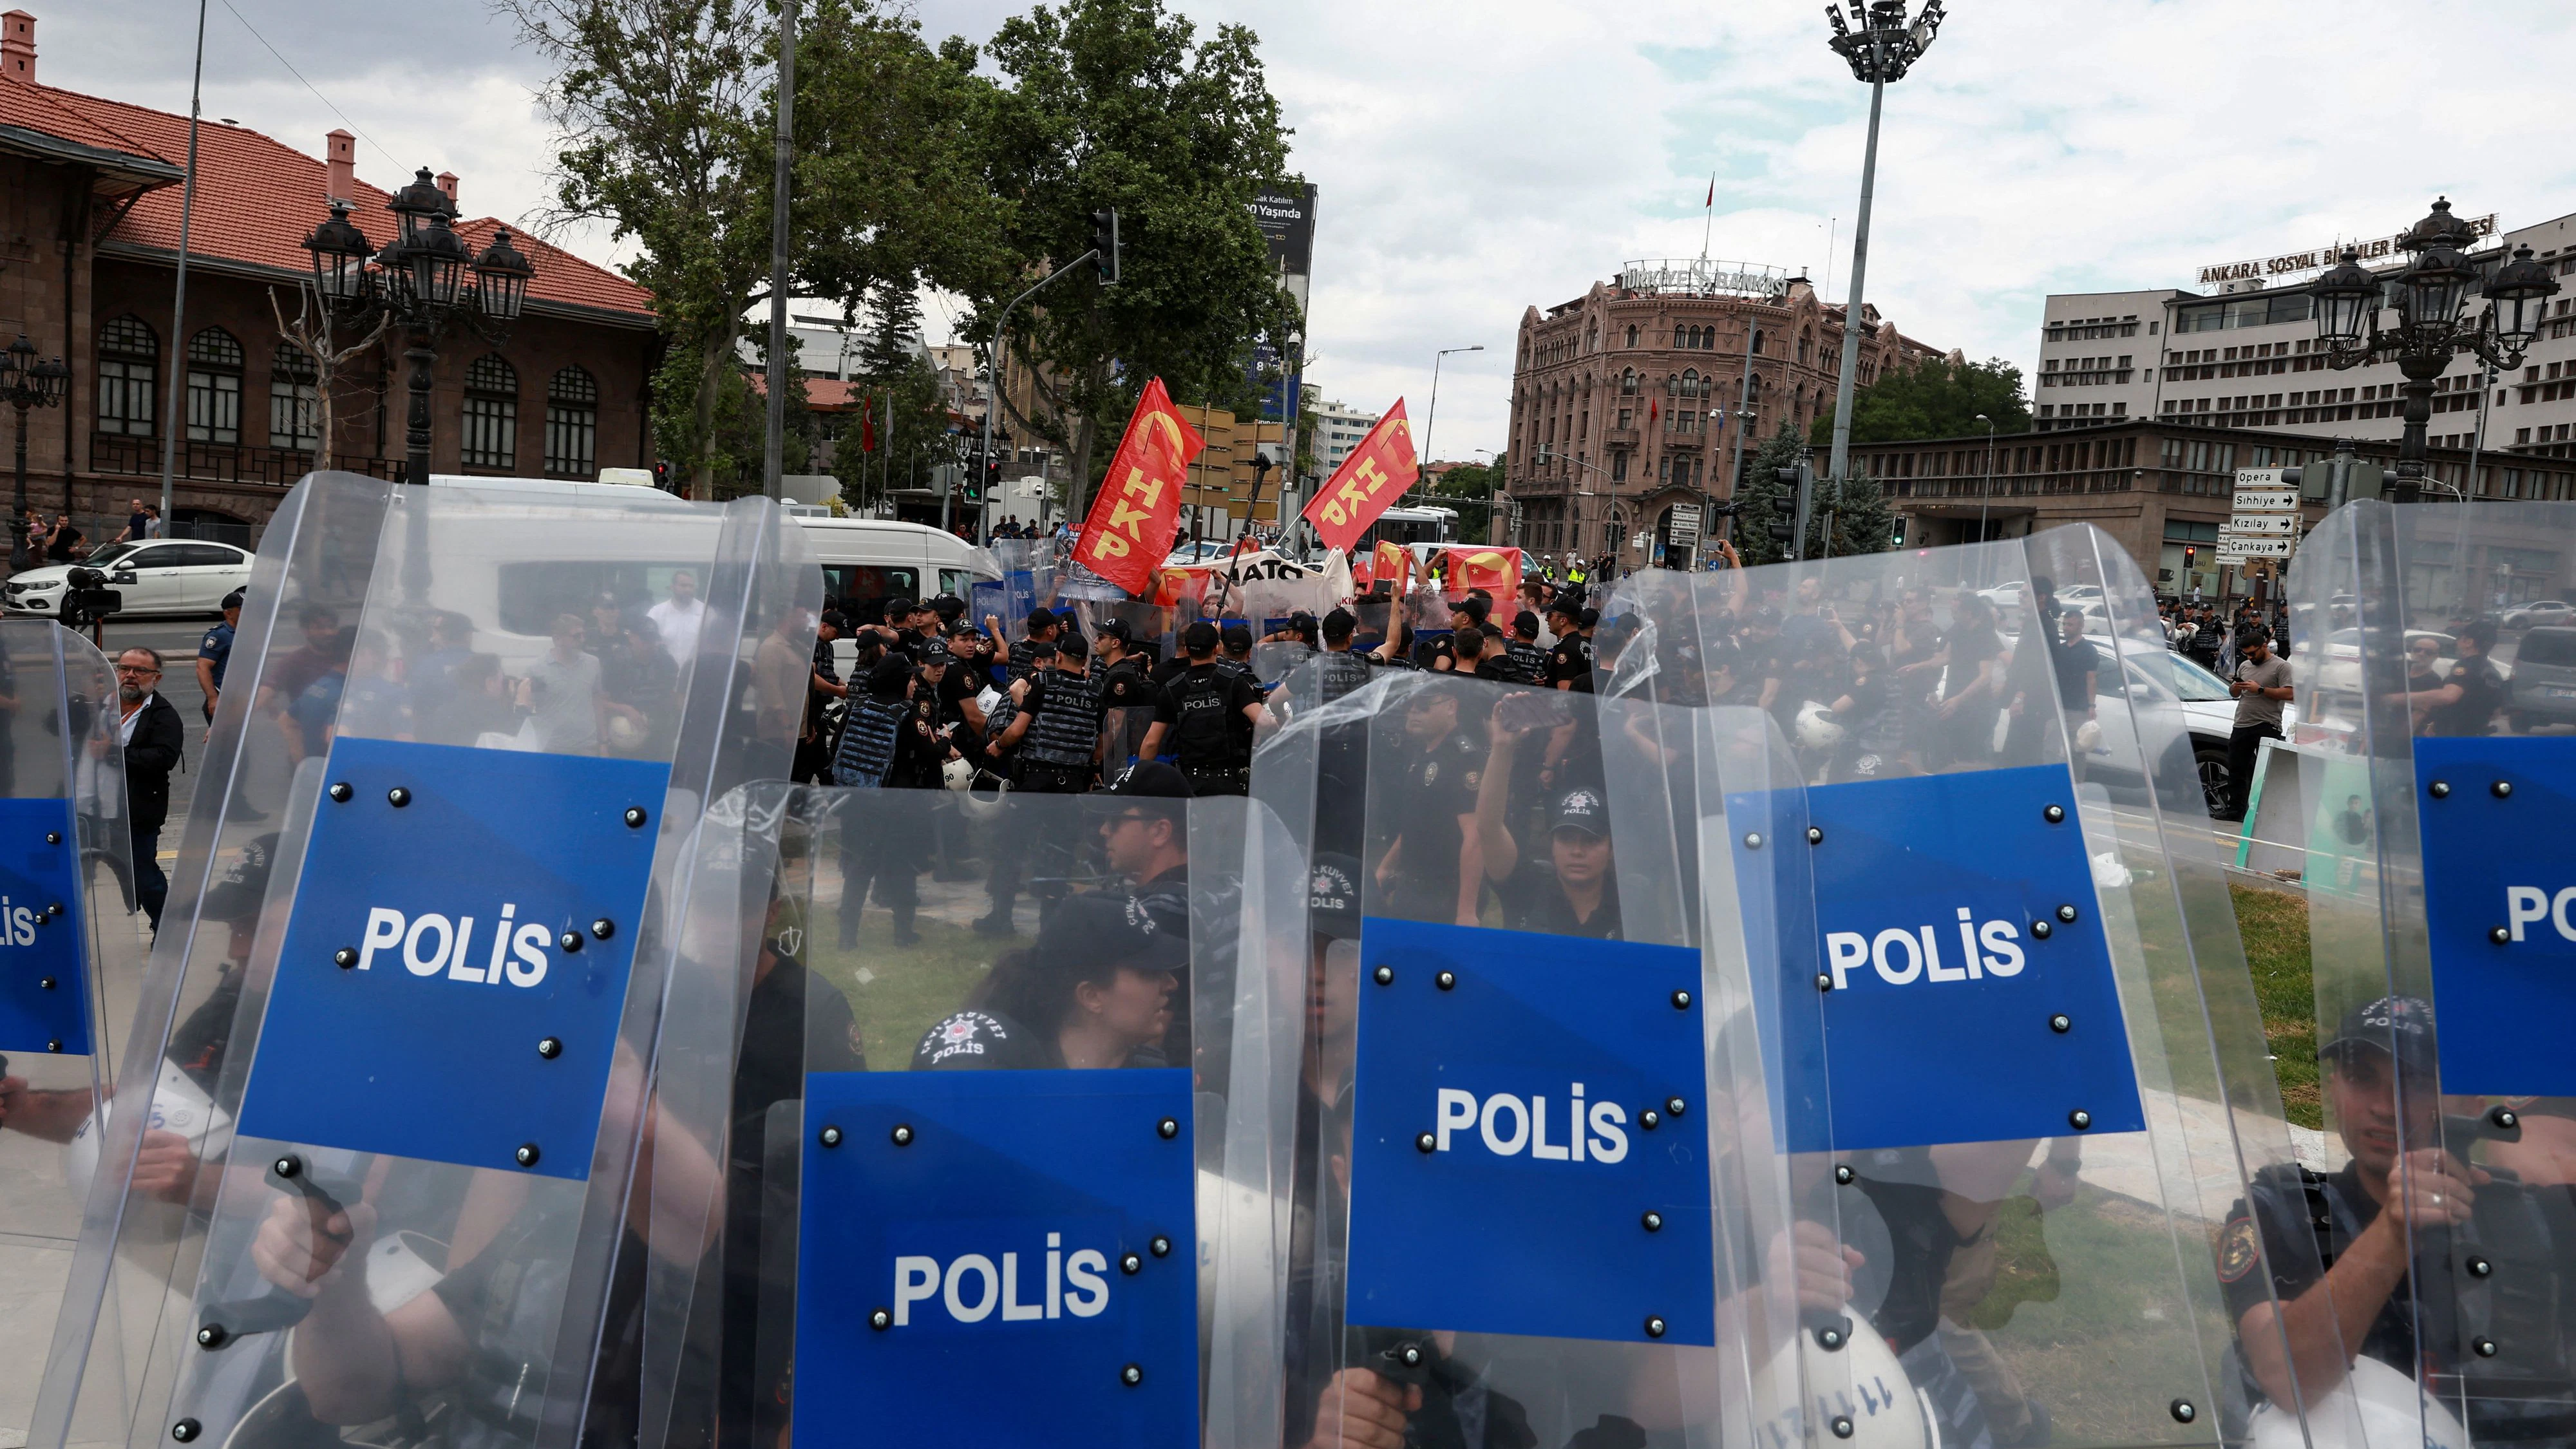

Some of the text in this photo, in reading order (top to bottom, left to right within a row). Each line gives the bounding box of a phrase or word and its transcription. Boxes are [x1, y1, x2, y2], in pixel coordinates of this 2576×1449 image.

[1259, 205, 1301, 219] Yaşında
[1269, 196, 1293, 205] Katılım
[2200, 240, 2390, 283] ANKARA SOSYAL BİLMLER
[1620, 266, 1689, 290] TÜRKİYE
[1716, 272, 1788, 297] BANKASI
[1320, 455, 1388, 526] HKP
[2239, 473, 2271, 484] Opera
[1092, 466, 1164, 561] HKP
[2236, 495, 2275, 507] Sıhhiye
[2233, 518, 2268, 530] Kızılay
[2231, 542, 2273, 553] Çankaya
[1213, 559, 1303, 590] NATO
[1323, 672, 1357, 683] POLİS
[1056, 694, 1092, 708] POLİS
[1184, 696, 1220, 711] POLİS
[945, 773, 954, 782] 90
[1563, 808, 1591, 816] POLİS
[1320, 864, 1354, 896] KUVVET
[357, 903, 552, 988] POLİS
[1826, 907, 2025, 990] POLİS
[956, 1012, 1007, 1039] KUVVET
[932, 1040, 984, 1065] POLİS
[1436, 1083, 1629, 1164] POLİS
[894, 1233, 1110, 1326] POLİS
